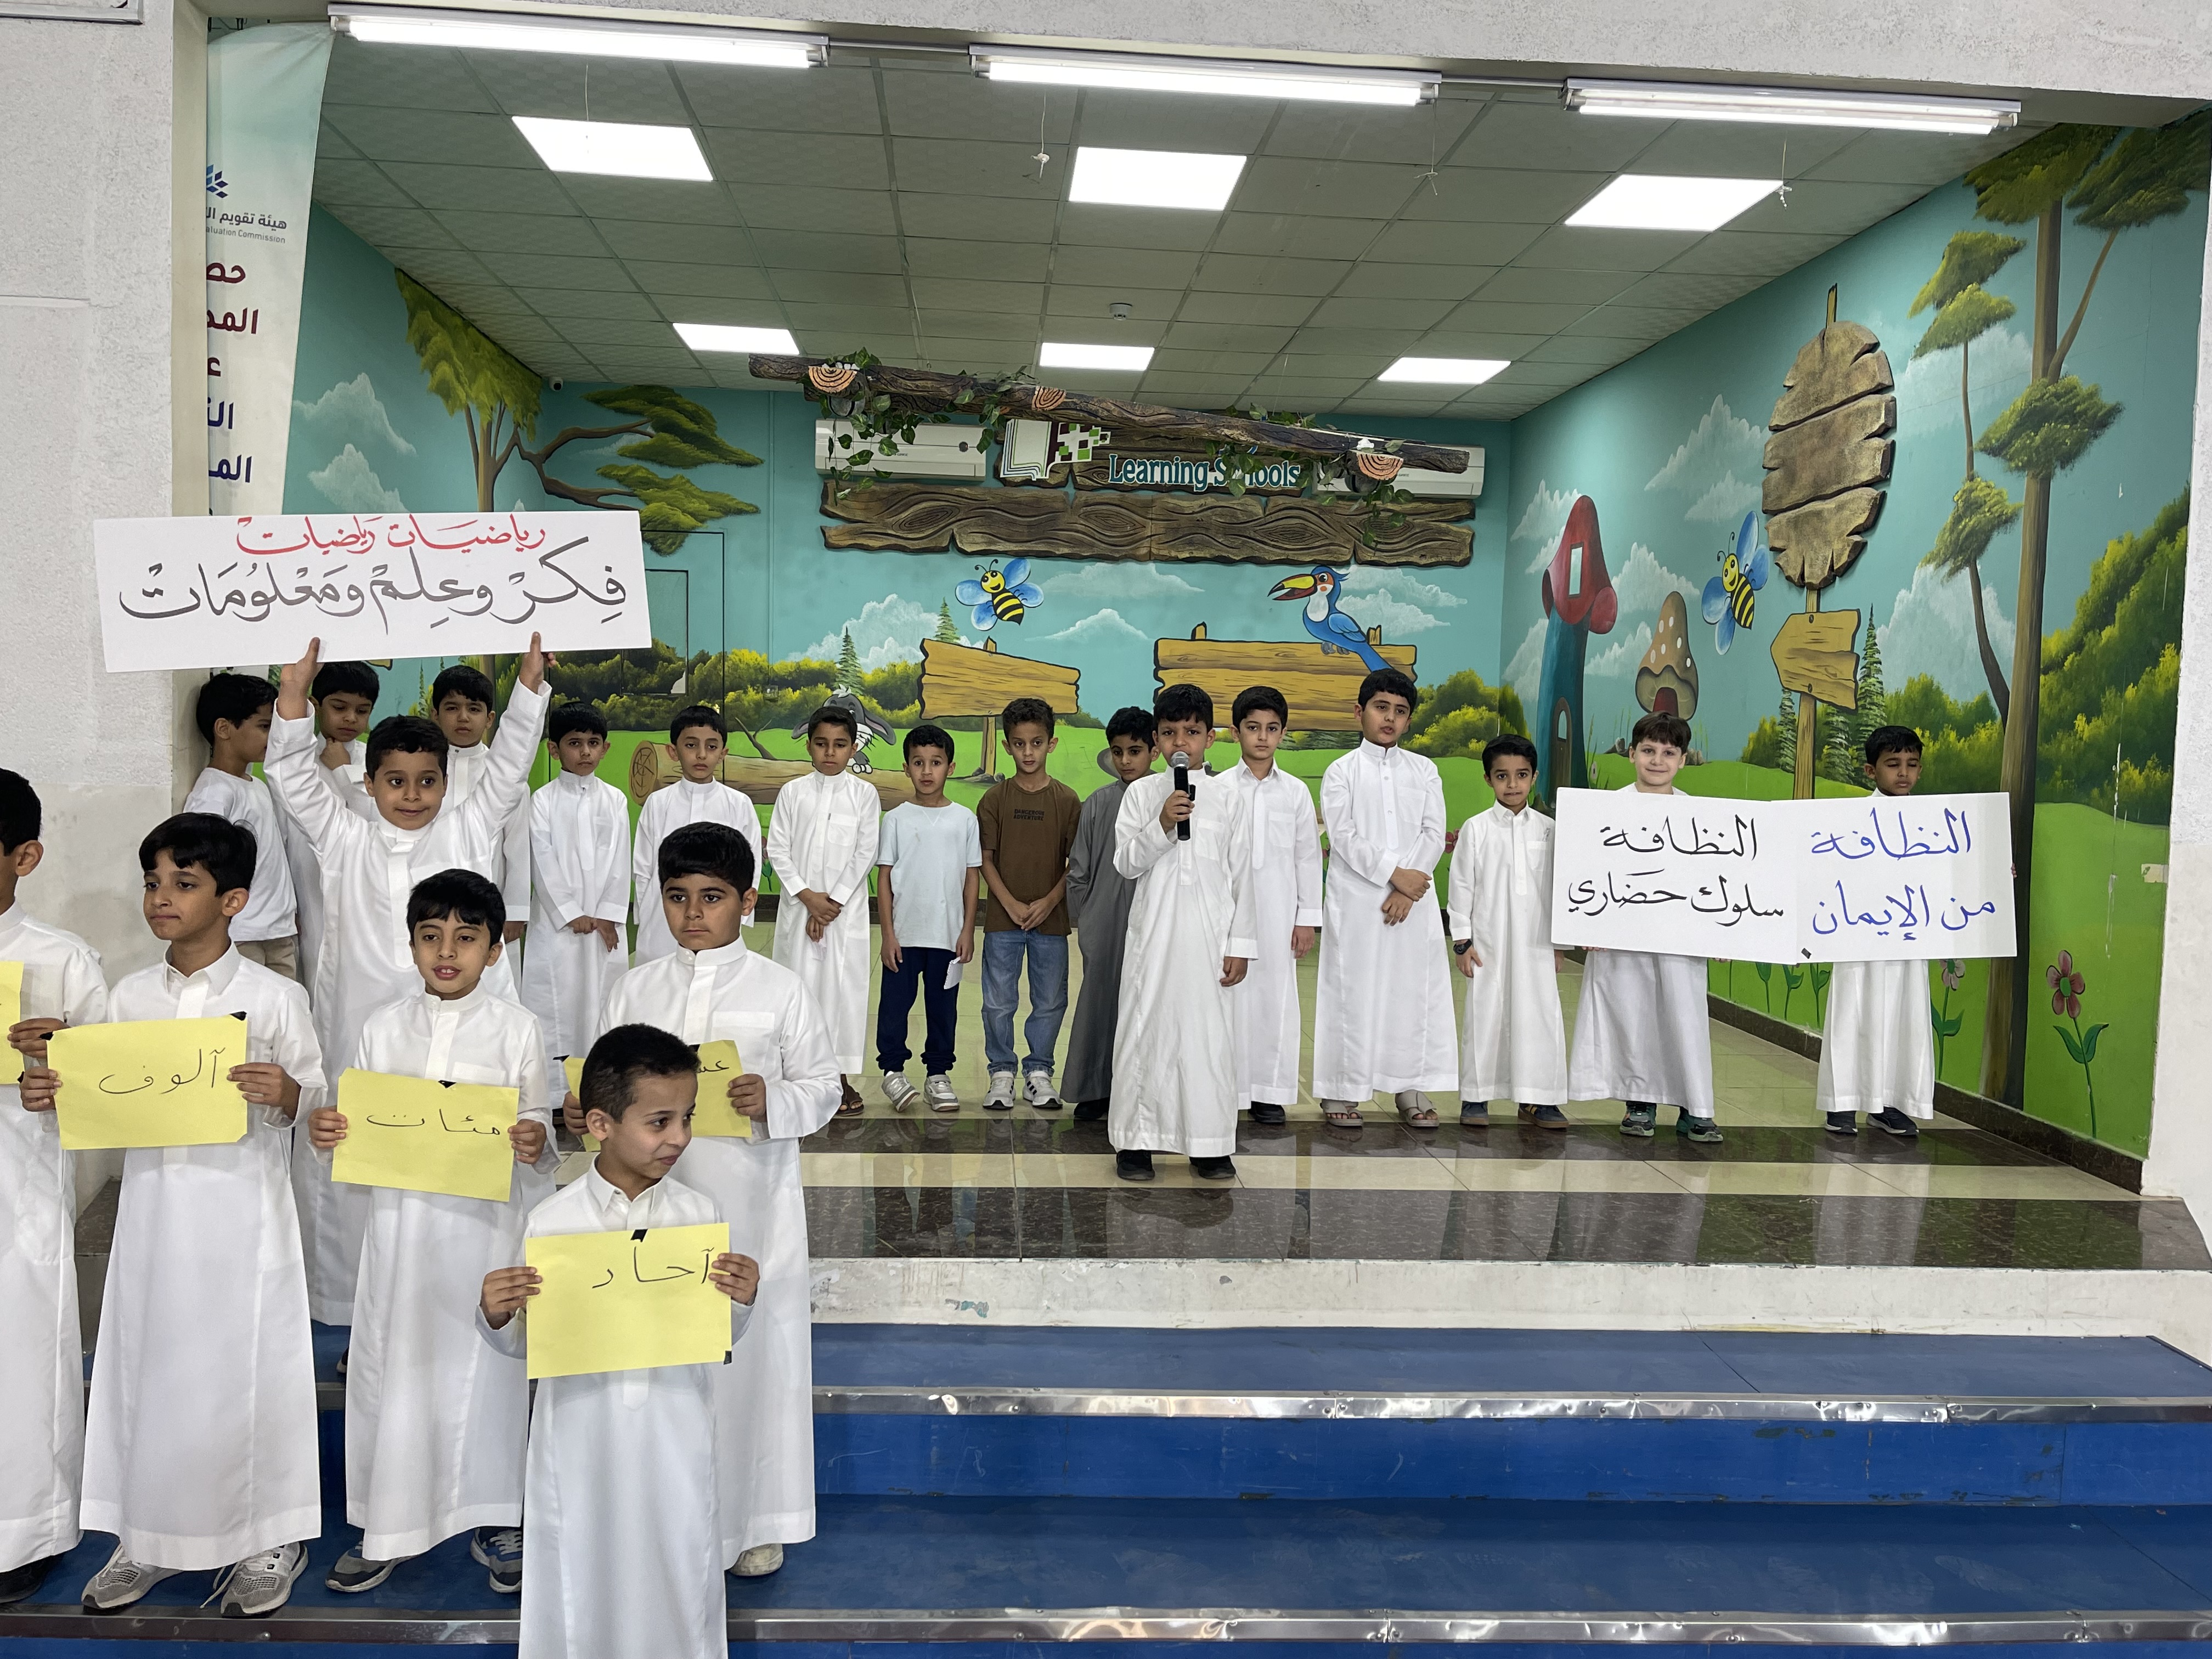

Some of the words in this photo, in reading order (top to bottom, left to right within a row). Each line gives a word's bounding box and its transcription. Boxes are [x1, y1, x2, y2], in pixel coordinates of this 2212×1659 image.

[206, 207, 216, 219] ال
[219, 212, 255, 225] تقويم
[258, 215, 287, 231] هيئة
[206, 226, 236, 236] aluation
[238, 229, 285, 244] Commission
[206, 262, 246, 284] حص
[208, 455, 252, 483] الم
[1109, 454, 1209, 491] Learning
[1214, 458, 1300, 487] Sools
[1600, 814, 1757, 861] النظافة
[1811, 807, 1972, 861] النظافة
[1691, 874, 1784, 927] سلوك
[1813, 880, 1931, 940] الإيمان
[1941, 897, 1995, 931] من
[366, 1108, 501, 1136] مئات
[592, 1246, 714, 1289] آحاد
